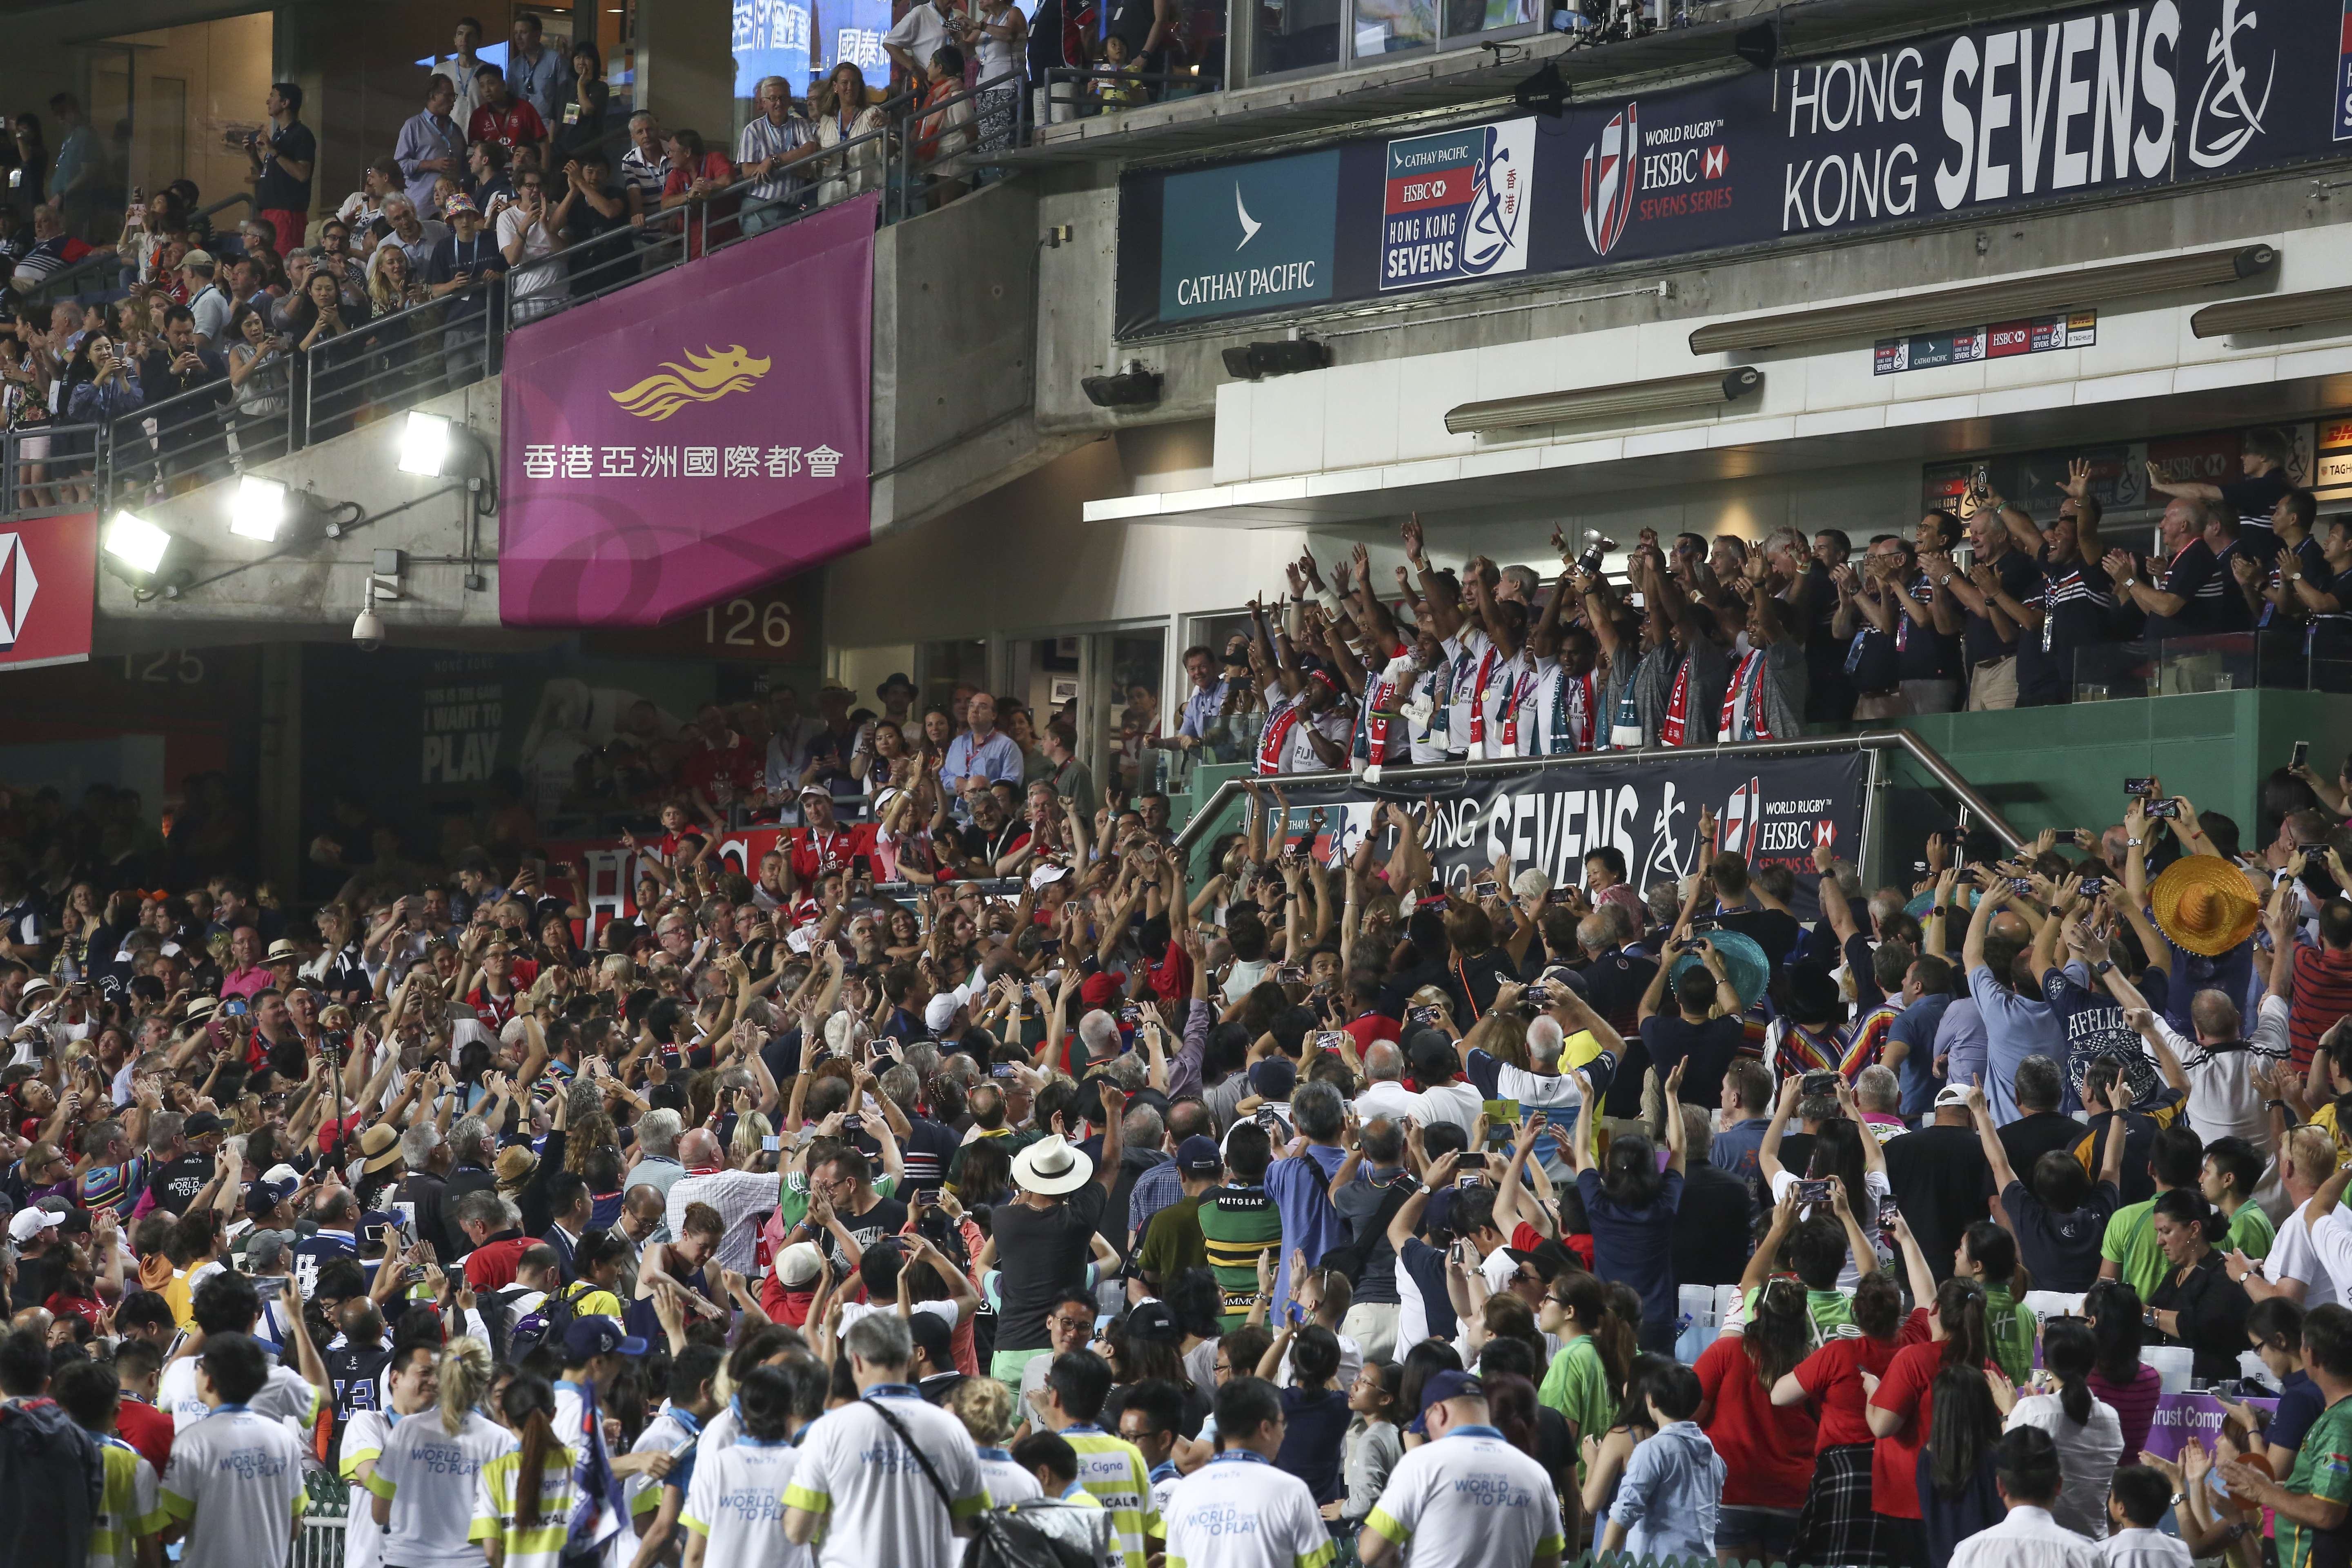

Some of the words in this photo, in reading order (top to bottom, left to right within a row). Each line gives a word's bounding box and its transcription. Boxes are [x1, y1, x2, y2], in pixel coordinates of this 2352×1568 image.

[1789, 47, 1924, 138] HONG
[1935, 0, 2181, 210] SEVENS
[1646, 127, 1682, 147] WORLD
[1405, 151, 1437, 168] CATHAY
[1439, 145, 1469, 162] PACIFIC
[1642, 148, 1698, 190] HSBC
[1403, 182, 1431, 203] HSBC
[1505, 169, 1517, 214] 香港
[1783, 143, 1918, 231] KONG
[1640, 194, 1687, 221] SEVENS
[1690, 186, 1732, 214] SERIES
[1389, 218, 1420, 244] HONG
[1425, 213, 1456, 239] KONG
[1388, 241, 1454, 278] SEVENS
[1178, 271, 1247, 306] CATHAY
[1250, 261, 1315, 296] PACIFIC
[1993, 332, 2014, 346] HSBC
[2033, 340, 2049, 348] SEVENS
[1914, 356, 1931, 365] CATHAY
[1954, 352, 1970, 360] SEVENS
[1877, 363, 1892, 371] SEVENS
[2328, 424, 2352, 441] DH
[523, 444, 844, 479] 香港亞洲國際都會
[2330, 465, 2352, 476] TAGH
[1943, 497, 1957, 508] KONG
[705, 598, 791, 647] 126
[125, 648, 204, 684] 125
[433, 705, 478, 732] WANT
[483, 703, 502, 728] TO
[422, 731, 501, 784] PLAY
[1765, 801, 1797, 815] WORLD
[1760, 820, 1811, 851] HSBC
[817, 860, 844, 874] HSBC
[2067, 1006, 2135, 1041] AFFLIC
[2073, 1040, 2082, 1050] MC
[168, 1181, 199, 1191] WORLD
[178, 1188, 190, 1197] TO
[178, 1401, 209, 1412] WOR
[2185, 1405, 2227, 1433] Comp
[220, 1453, 266, 1471] WORLD
[412, 1449, 461, 1463] WORLD
[237, 1467, 254, 1480] TO
[258, 1463, 287, 1477] PLAY
[427, 1461, 446, 1473] TO
[448, 1463, 480, 1476] PLAY
[1092, 1462, 1123, 1474] Cigna
[1455, 1479, 1509, 1493] WORLD
[719, 1495, 775, 1508] WORLD
[1474, 1492, 1493, 1506] TO
[1497, 1494, 1531, 1507] PLAY
[738, 1508, 757, 1520] TO
[1187, 1509, 1236, 1526] WORLD
[1204, 1523, 1222, 1536] TO
[1225, 1521, 1258, 1535] PLAY
